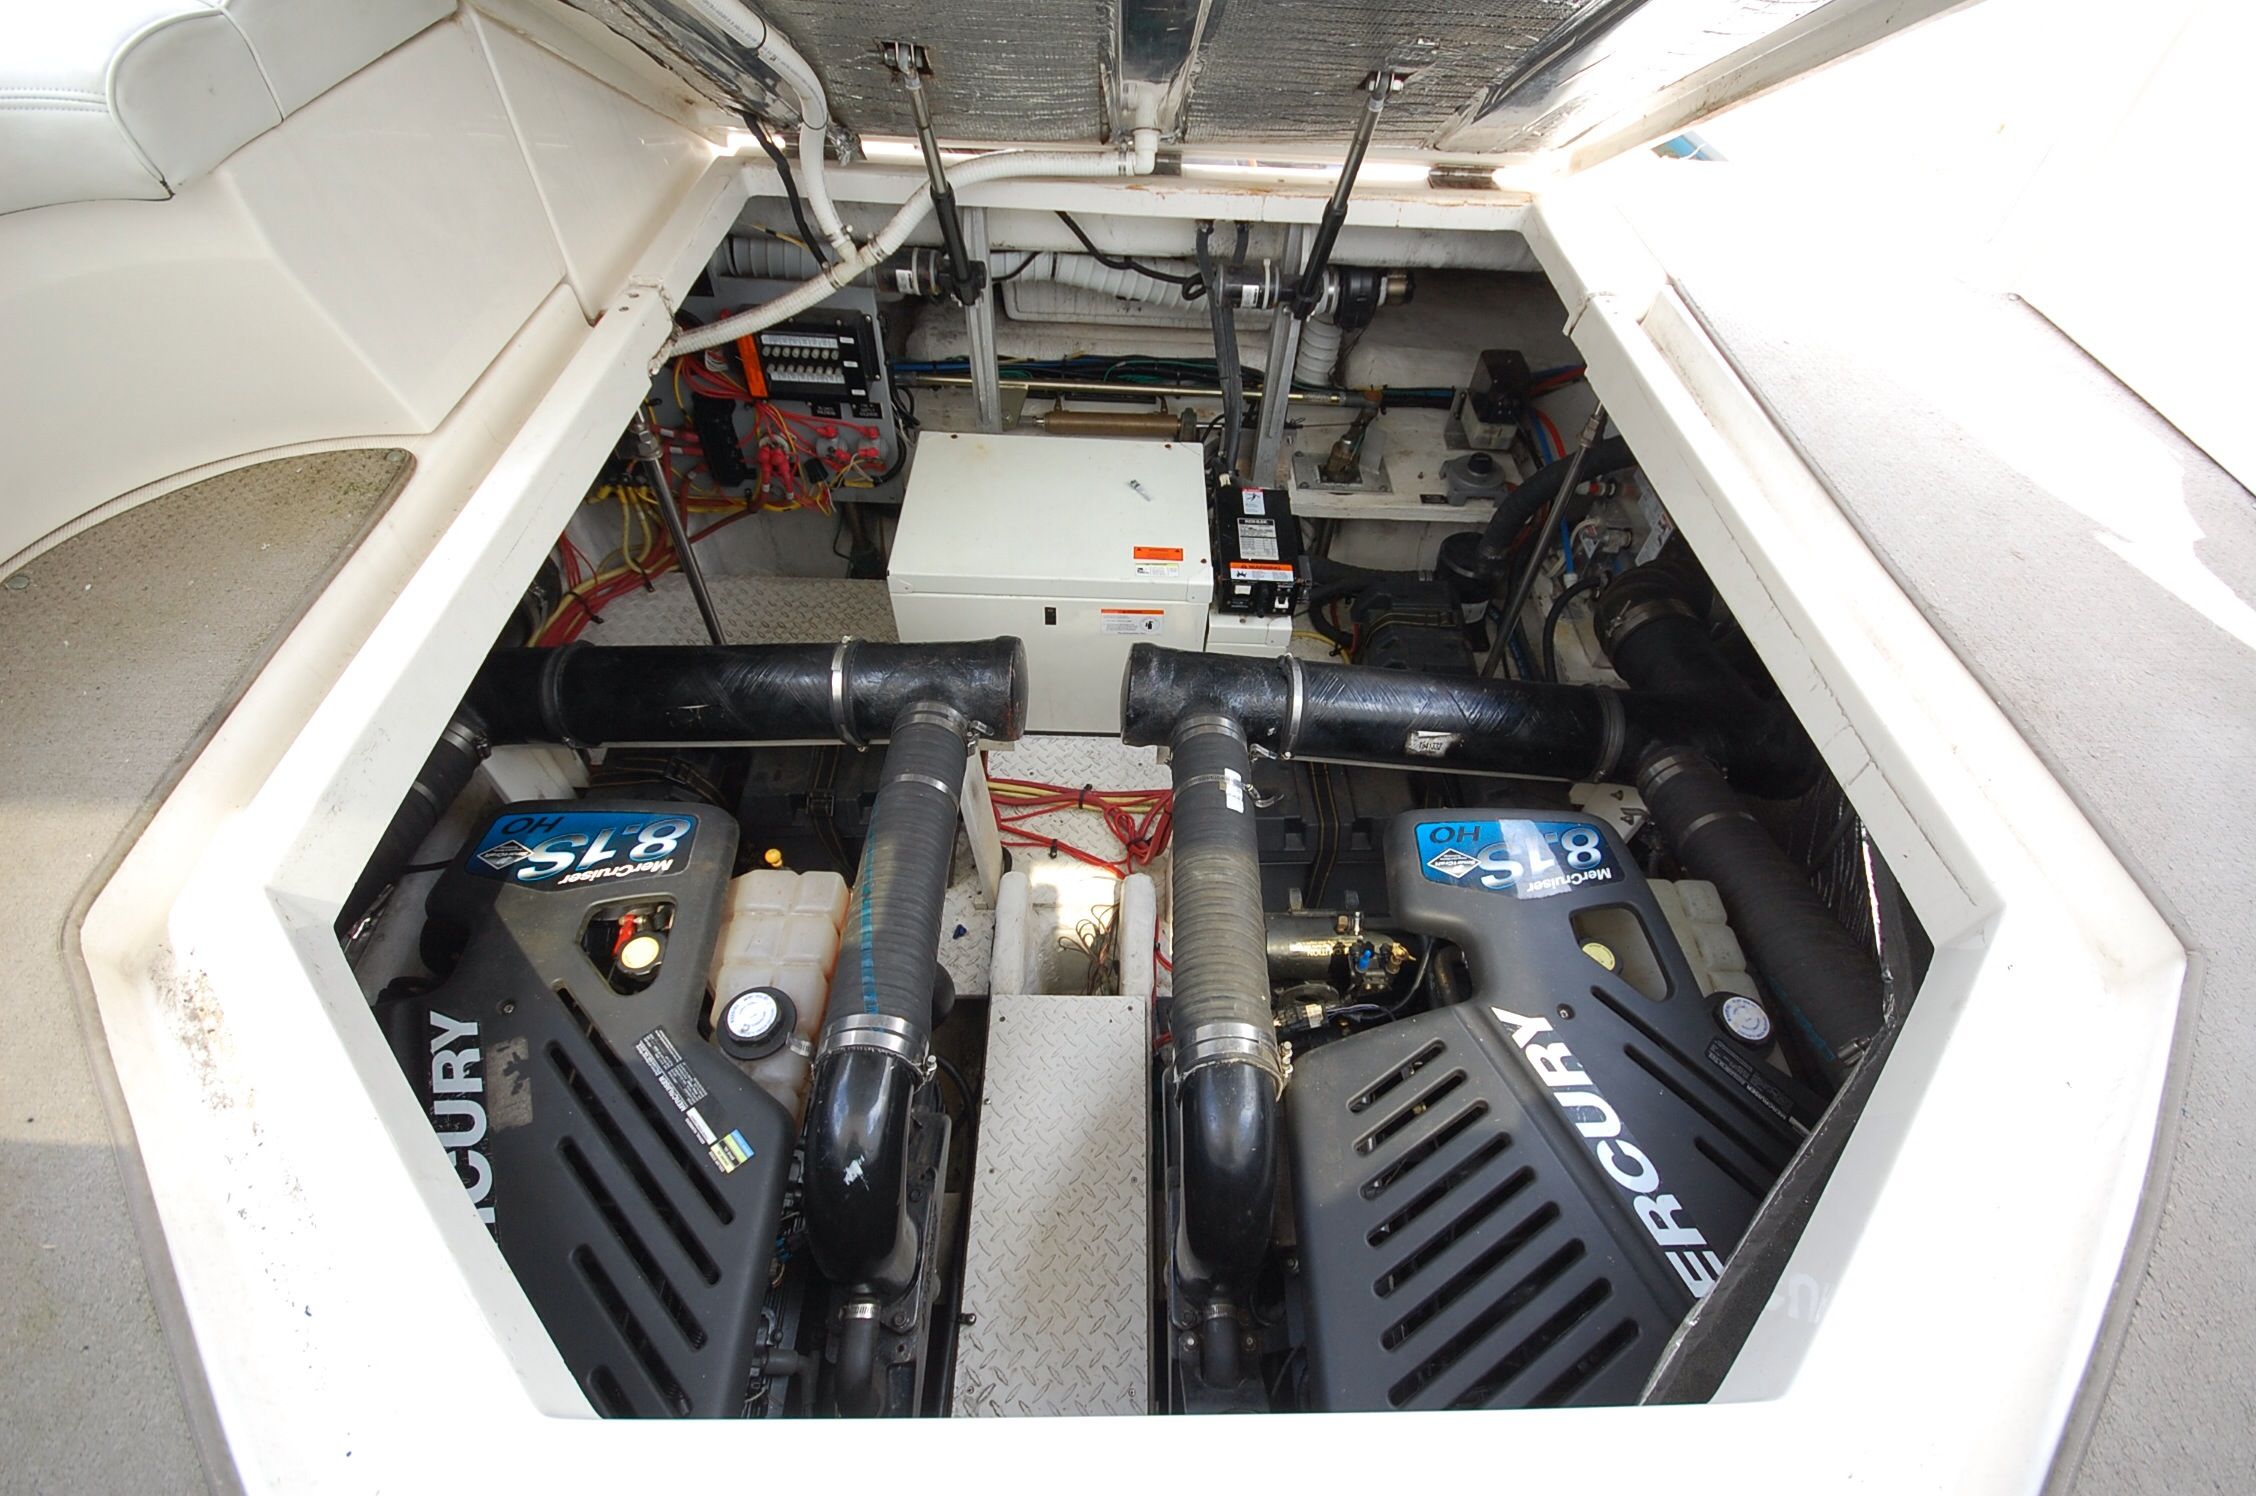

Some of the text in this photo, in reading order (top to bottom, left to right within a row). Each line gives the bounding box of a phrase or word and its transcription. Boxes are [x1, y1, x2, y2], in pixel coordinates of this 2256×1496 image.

[501, 816, 564, 836] HO
[1429, 825, 1481, 844] HO
[517, 818, 692, 881] 8.1S
[1476, 827, 1603, 890] 8.1S
[557, 858, 674, 886] MerCruiser
[1525, 866, 1613, 893] MerCruiser
